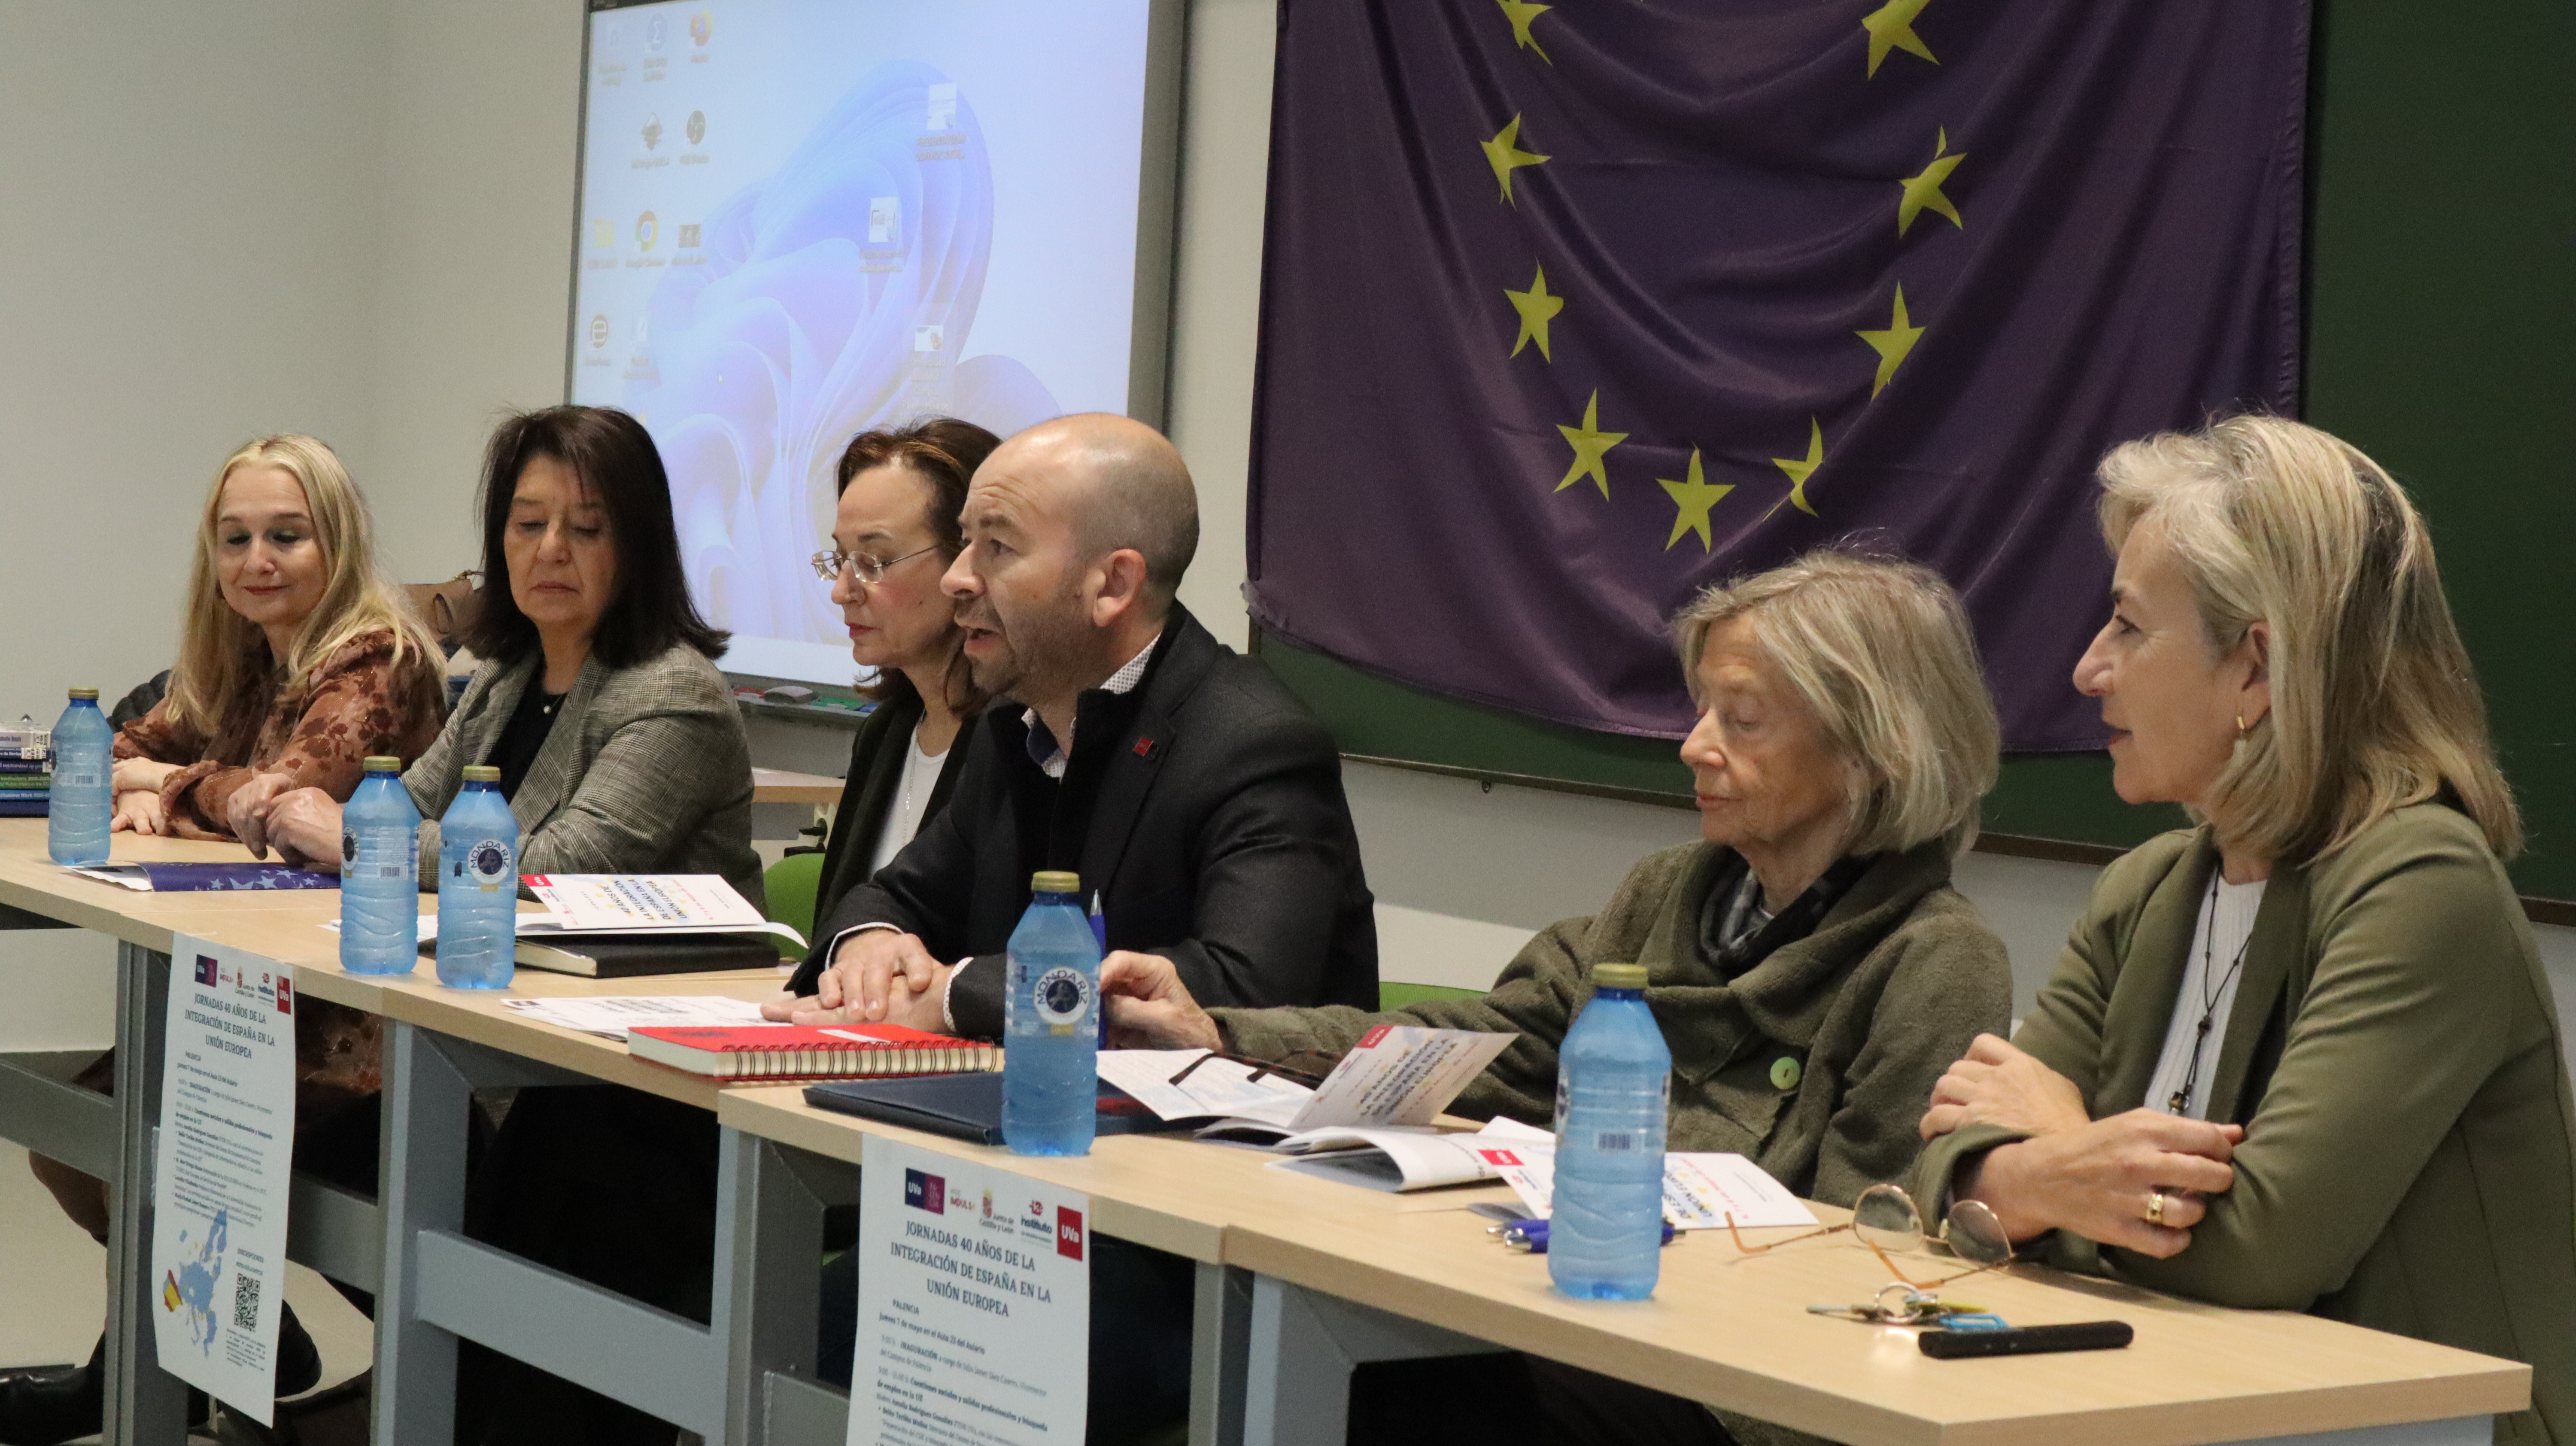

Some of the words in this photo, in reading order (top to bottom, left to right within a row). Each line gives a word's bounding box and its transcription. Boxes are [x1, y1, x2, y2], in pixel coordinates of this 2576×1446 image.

[471, 841, 509, 868] MONDARIZ
[532, 876, 546, 884] UVa
[605, 893, 625, 905] AÑOS
[611, 880, 647, 912] INTEGRACIÓN
[645, 881, 672, 902] EUROPEA
[639, 893, 665, 911] ESPAÑA
[665, 903, 688, 918] UNIÓN
[197, 964, 205, 974] UVa
[279, 989, 289, 1002] UVa
[1037, 970, 1088, 1004] MONDARIZ
[194, 993, 223, 1012] JORNADAS
[225, 1002, 230, 1013] 40
[231, 1002, 248, 1019] AÑOS
[249, 1010, 256, 1021] DE
[258, 1012, 266, 1024] LA
[185, 1008, 222, 1030] INTEGRACIÓN
[224, 1021, 231, 1033] DE
[232, 1022, 255, 1040] ESPAÑA
[258, 1032, 265, 1044] EN
[267, 1035, 274, 1046] LA
[1367, 1028, 1386, 1044] UVa
[185, 1051, 200, 1061] PALENCIA
[205, 1033, 223, 1049] UNIÓN
[225, 1041, 252, 1059] EUROPEA
[908, 1181, 922, 1196] UVa
[1061, 1224, 1079, 1243] UVa
[905, 1220, 957, 1249] JORNADAS
[960, 1236, 972, 1252] 40
[975, 1237, 1002, 1262] AÑOS
[1005, 1249, 1018, 1266] DE
[1021, 1254, 1035, 1271] LA
[890, 1239, 957, 1274] INTEGRACIÓN
[961, 1263, 973, 1279] DE
[976, 1264, 1017, 1293] ESPAÑA
[1020, 1281, 1034, 1298] EN
[1037, 1285, 1051, 1303] LA
[893, 1298, 919, 1315] PALENCIA
[927, 1276, 960, 1302] UNIÓN
[963, 1290, 1009, 1317] EUROPEA
[901, 1319, 907, 1328] de
[908, 1322, 922, 1335] mayo
[937, 1331, 948, 1342] Aula
